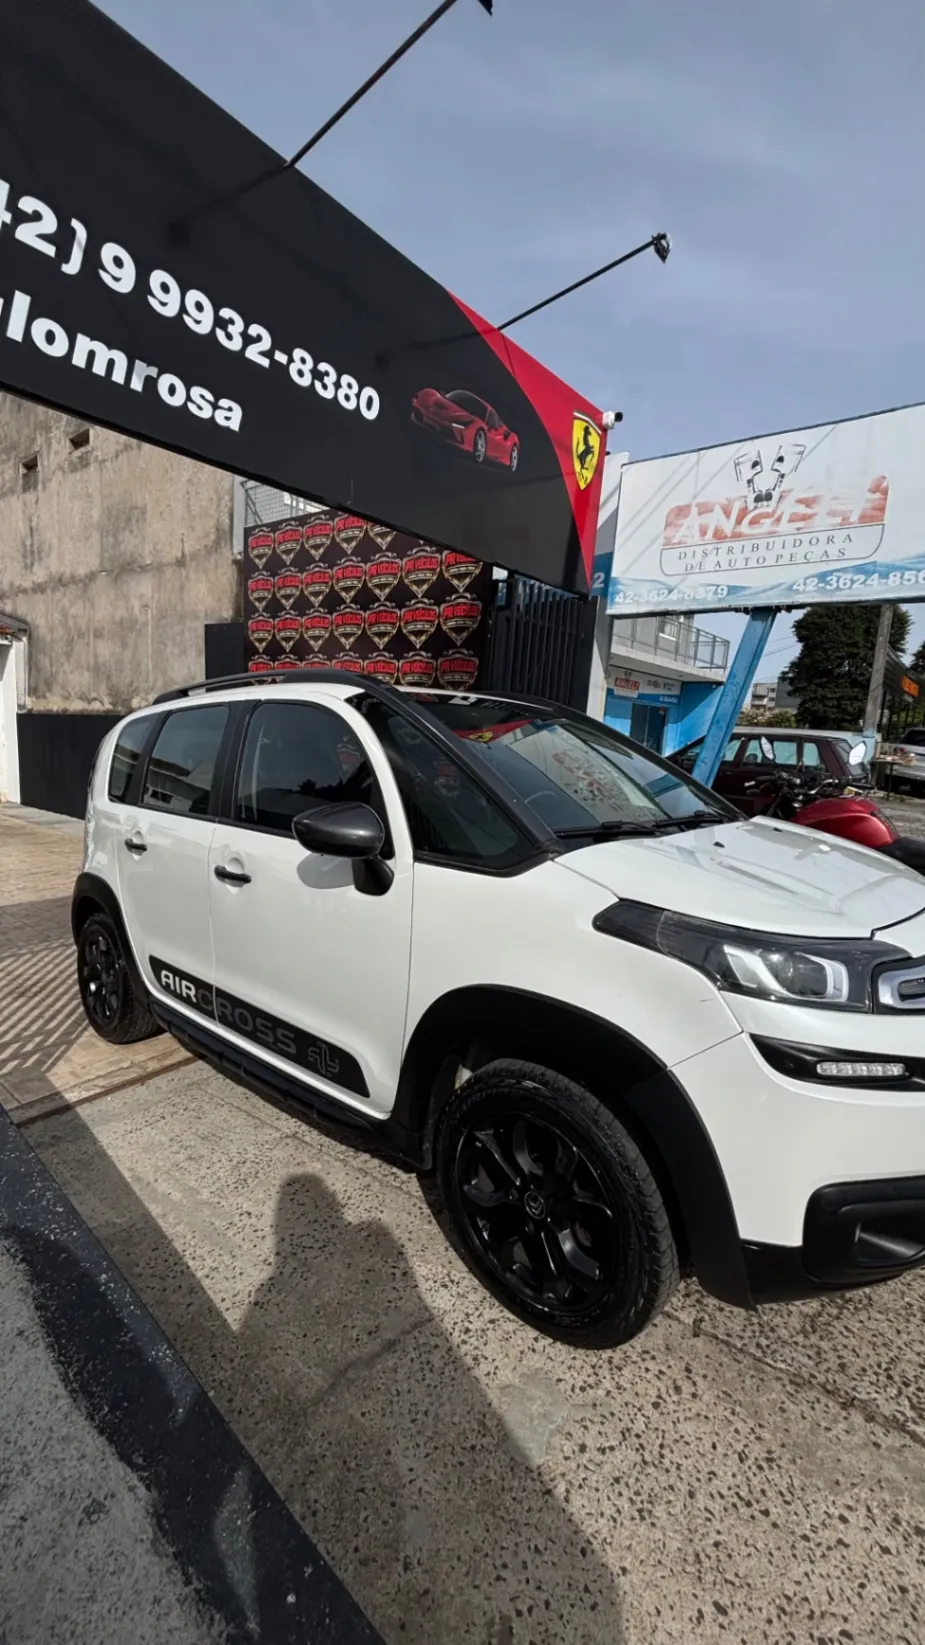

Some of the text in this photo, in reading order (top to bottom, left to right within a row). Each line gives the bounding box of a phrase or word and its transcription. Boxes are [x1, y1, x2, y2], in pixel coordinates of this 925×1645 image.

[0, 179, 380, 421] 2) 9 9932-8380
[0, 290, 243, 432] lomrosa
[677, 533, 854, 562] DISTRIBUIDORA
[684, 561, 707, 573] DE
[160, 969, 298, 1055] AIRCROSS
